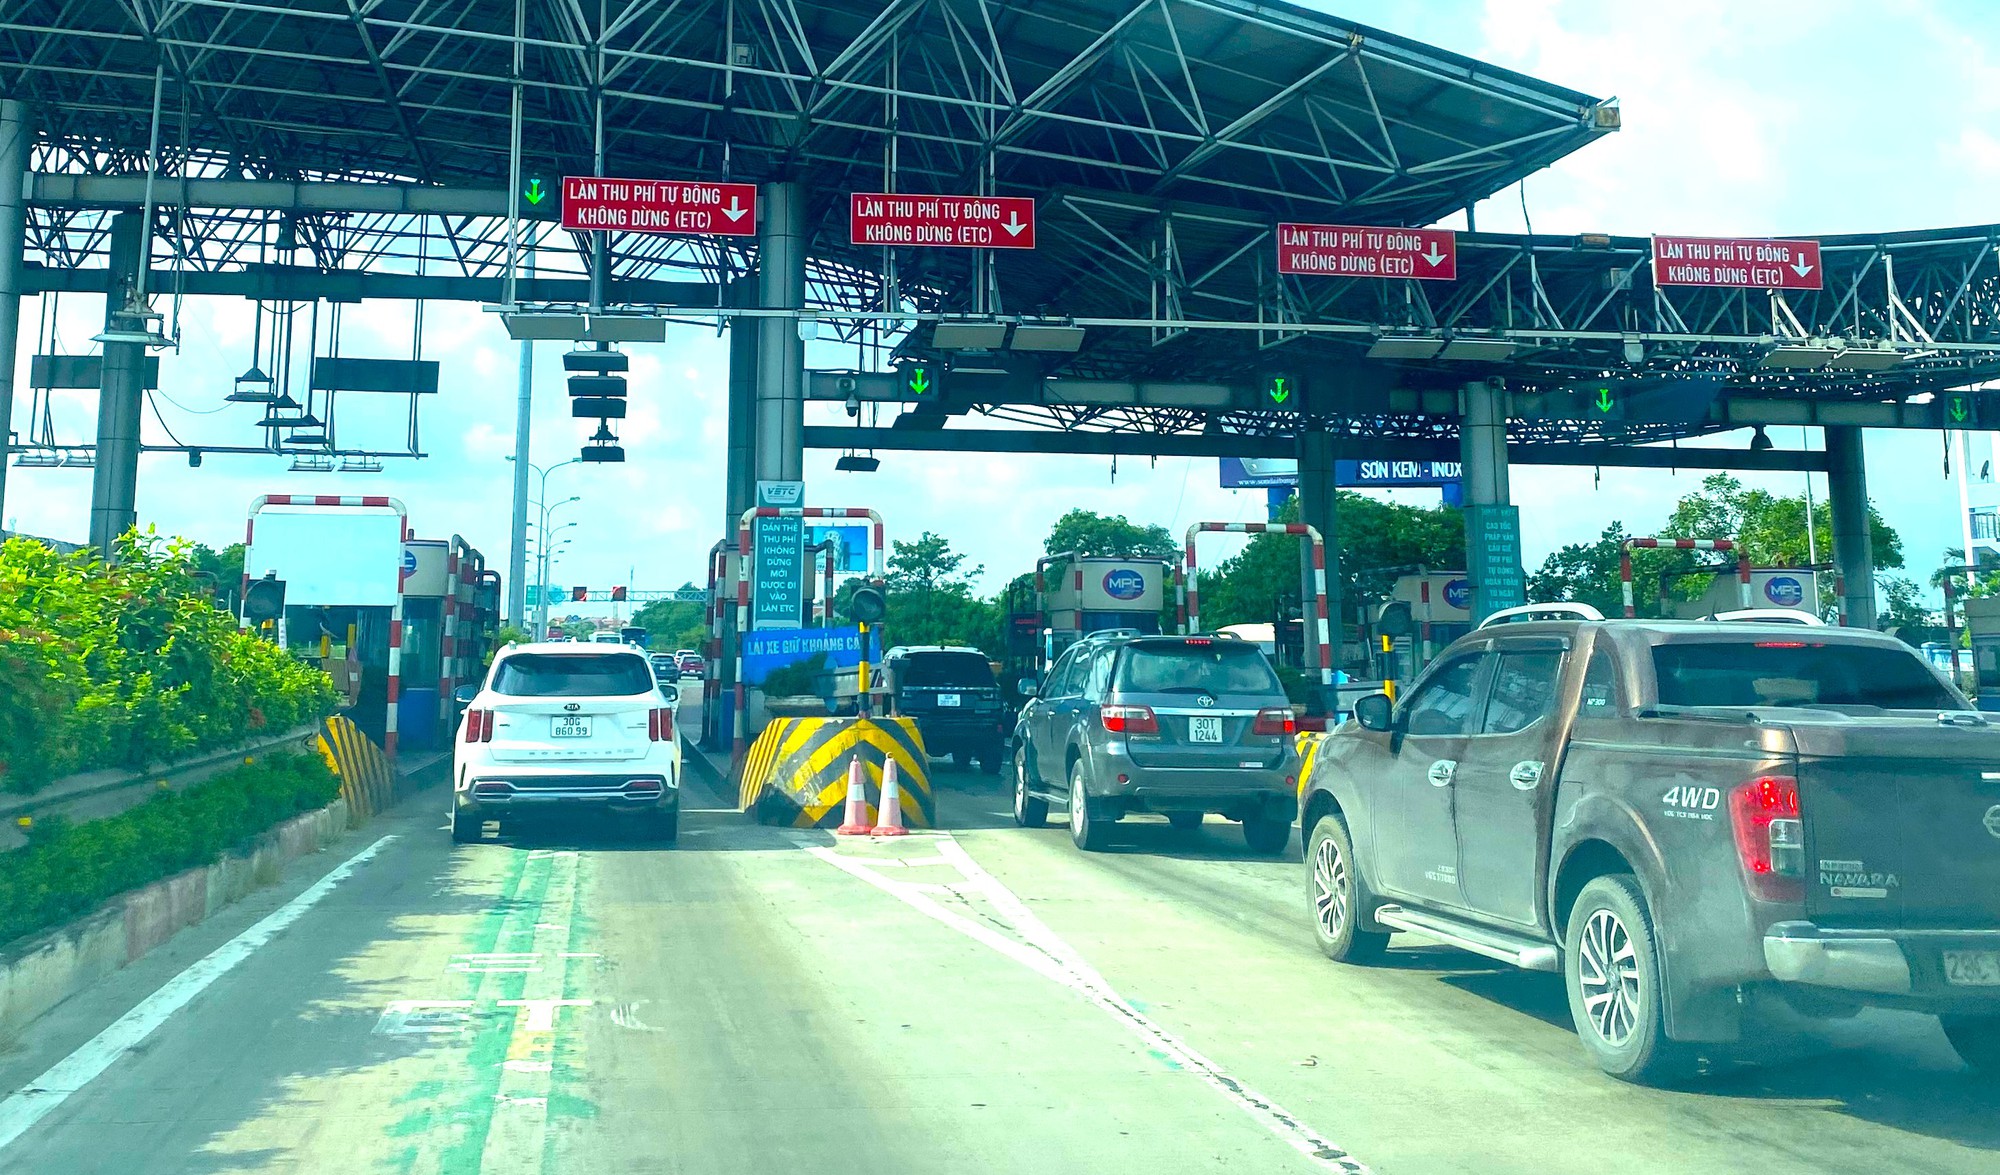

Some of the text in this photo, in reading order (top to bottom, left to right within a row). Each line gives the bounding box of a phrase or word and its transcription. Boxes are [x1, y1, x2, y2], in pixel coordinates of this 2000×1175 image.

[570, 179, 721, 206] LÀN THU PHÍ TỰ ĐỘNG
[578, 206, 711, 229] KHÔNG DỪNG (ETC)
[857, 197, 1000, 222] LÀN THU PHÍ TỰ ĐỘNG
[866, 222, 992, 243] KHÔNG DỪNG (ETC)
[1284, 226, 1421, 254] LÀN THU PHÍ TỰ ĐỘNG
[1660, 239, 1789, 265] LÀN THU PHÍ TỰ ĐỘNG
[1292, 251, 1414, 275] KHÔNG DỪNG (ETC)
[1668, 264, 1784, 285] KHÔNG DỪNG (ETC)
[1361, 461, 1389, 479] SƠN
[1431, 461, 1462, 478] INOX
[763, 535, 780, 543] THU
[782, 535, 796, 543] PHÍ
[770, 569, 787, 577] MỚI
[761, 580, 785, 590] ĐƯỢC
[1109, 578, 1142, 588] MPC
[1771, 585, 1800, 595] MPC
[770, 591, 786, 600] VÀO
[762, 602, 778, 612] LÀN
[748, 638, 764, 655] LÁI
[766, 641, 779, 654] XE
[783, 636, 800, 653] GIỮ
[802, 633, 843, 653] KHOẢNG
[563, 717, 580, 726] 30G
[1196, 718, 1215, 729] 30T
[1195, 730, 1217, 741] 1244
[1663, 786, 1720, 810] 4WD
[1820, 872, 1900, 887] NAVARA
